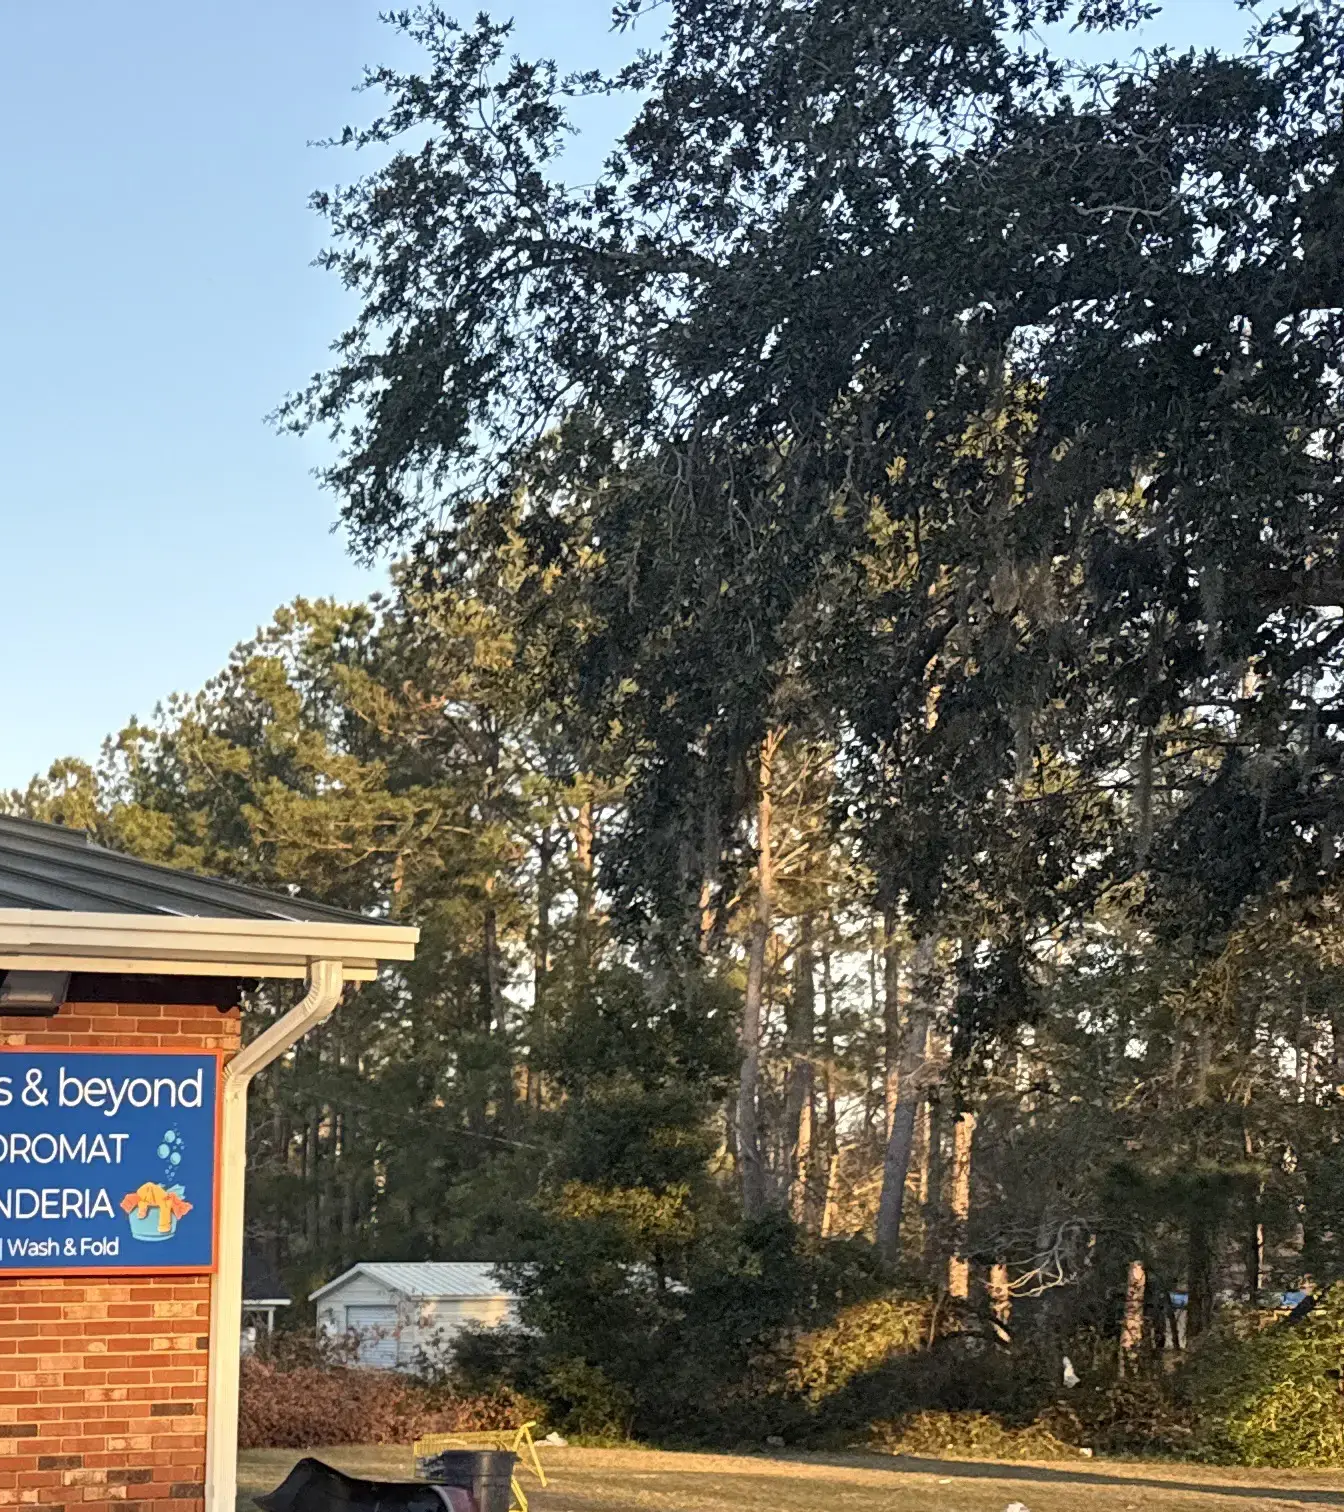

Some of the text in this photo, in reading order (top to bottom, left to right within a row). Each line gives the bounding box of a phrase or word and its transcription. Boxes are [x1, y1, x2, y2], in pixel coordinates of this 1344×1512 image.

[21, 1068, 49, 1107] &
[58, 1067, 203, 1117] beyond
[6, 1237, 60, 1257] Wash
[63, 1237, 78, 1257] &
[80, 1236, 120, 1257] Fold
